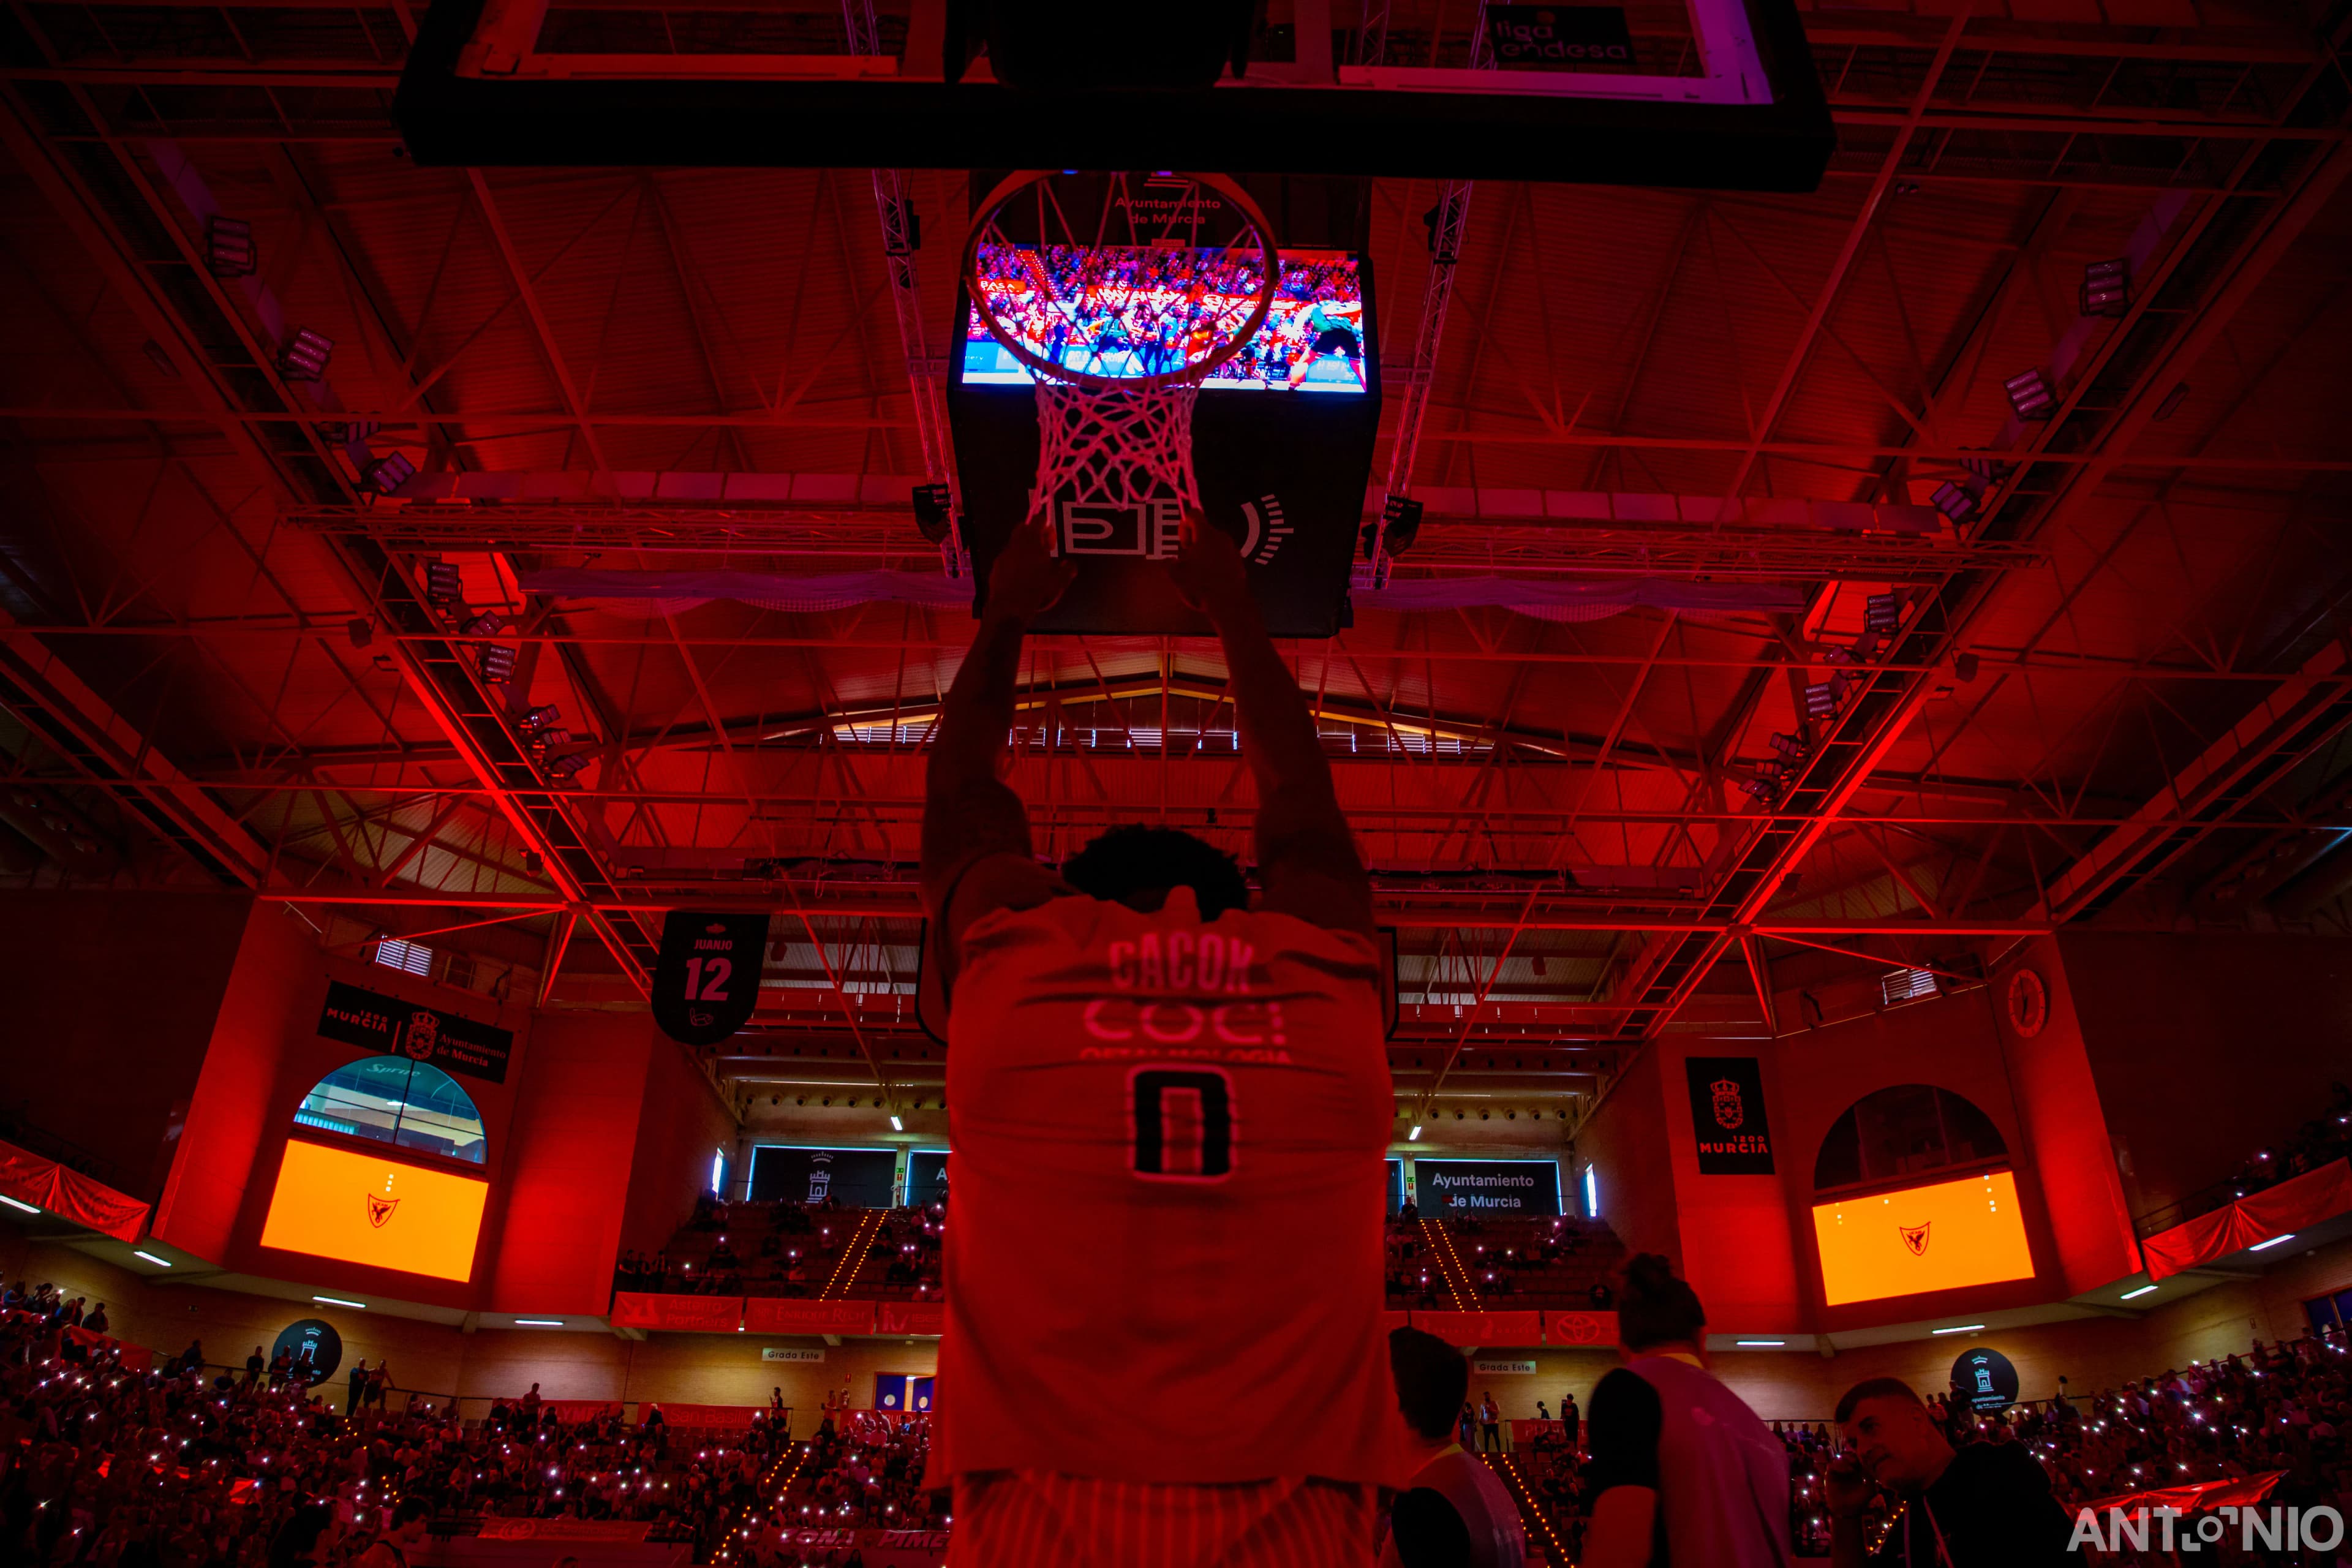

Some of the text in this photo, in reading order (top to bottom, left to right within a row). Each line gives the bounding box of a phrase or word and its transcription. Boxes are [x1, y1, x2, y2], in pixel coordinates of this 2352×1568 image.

[1496, 21, 1555, 41] liga
[1501, 40, 1627, 59] endesa
[1152, 214, 1206, 224] Murca
[694, 938, 733, 951] JUANJO
[685, 956, 733, 1001] 12
[326, 1007, 388, 1033] MURCIA
[439, 1033, 507, 1059] Ayuntamiento
[437, 1047, 489, 1068] de Murcia
[1126, 1063, 1239, 1185] 0
[1699, 1142, 1768, 1153] MURCIA
[1432, 1172, 1534, 1189] Ayuntamiento
[1447, 1193, 1522, 1208] de Murcia
[768, 1351, 797, 1359] Grada
